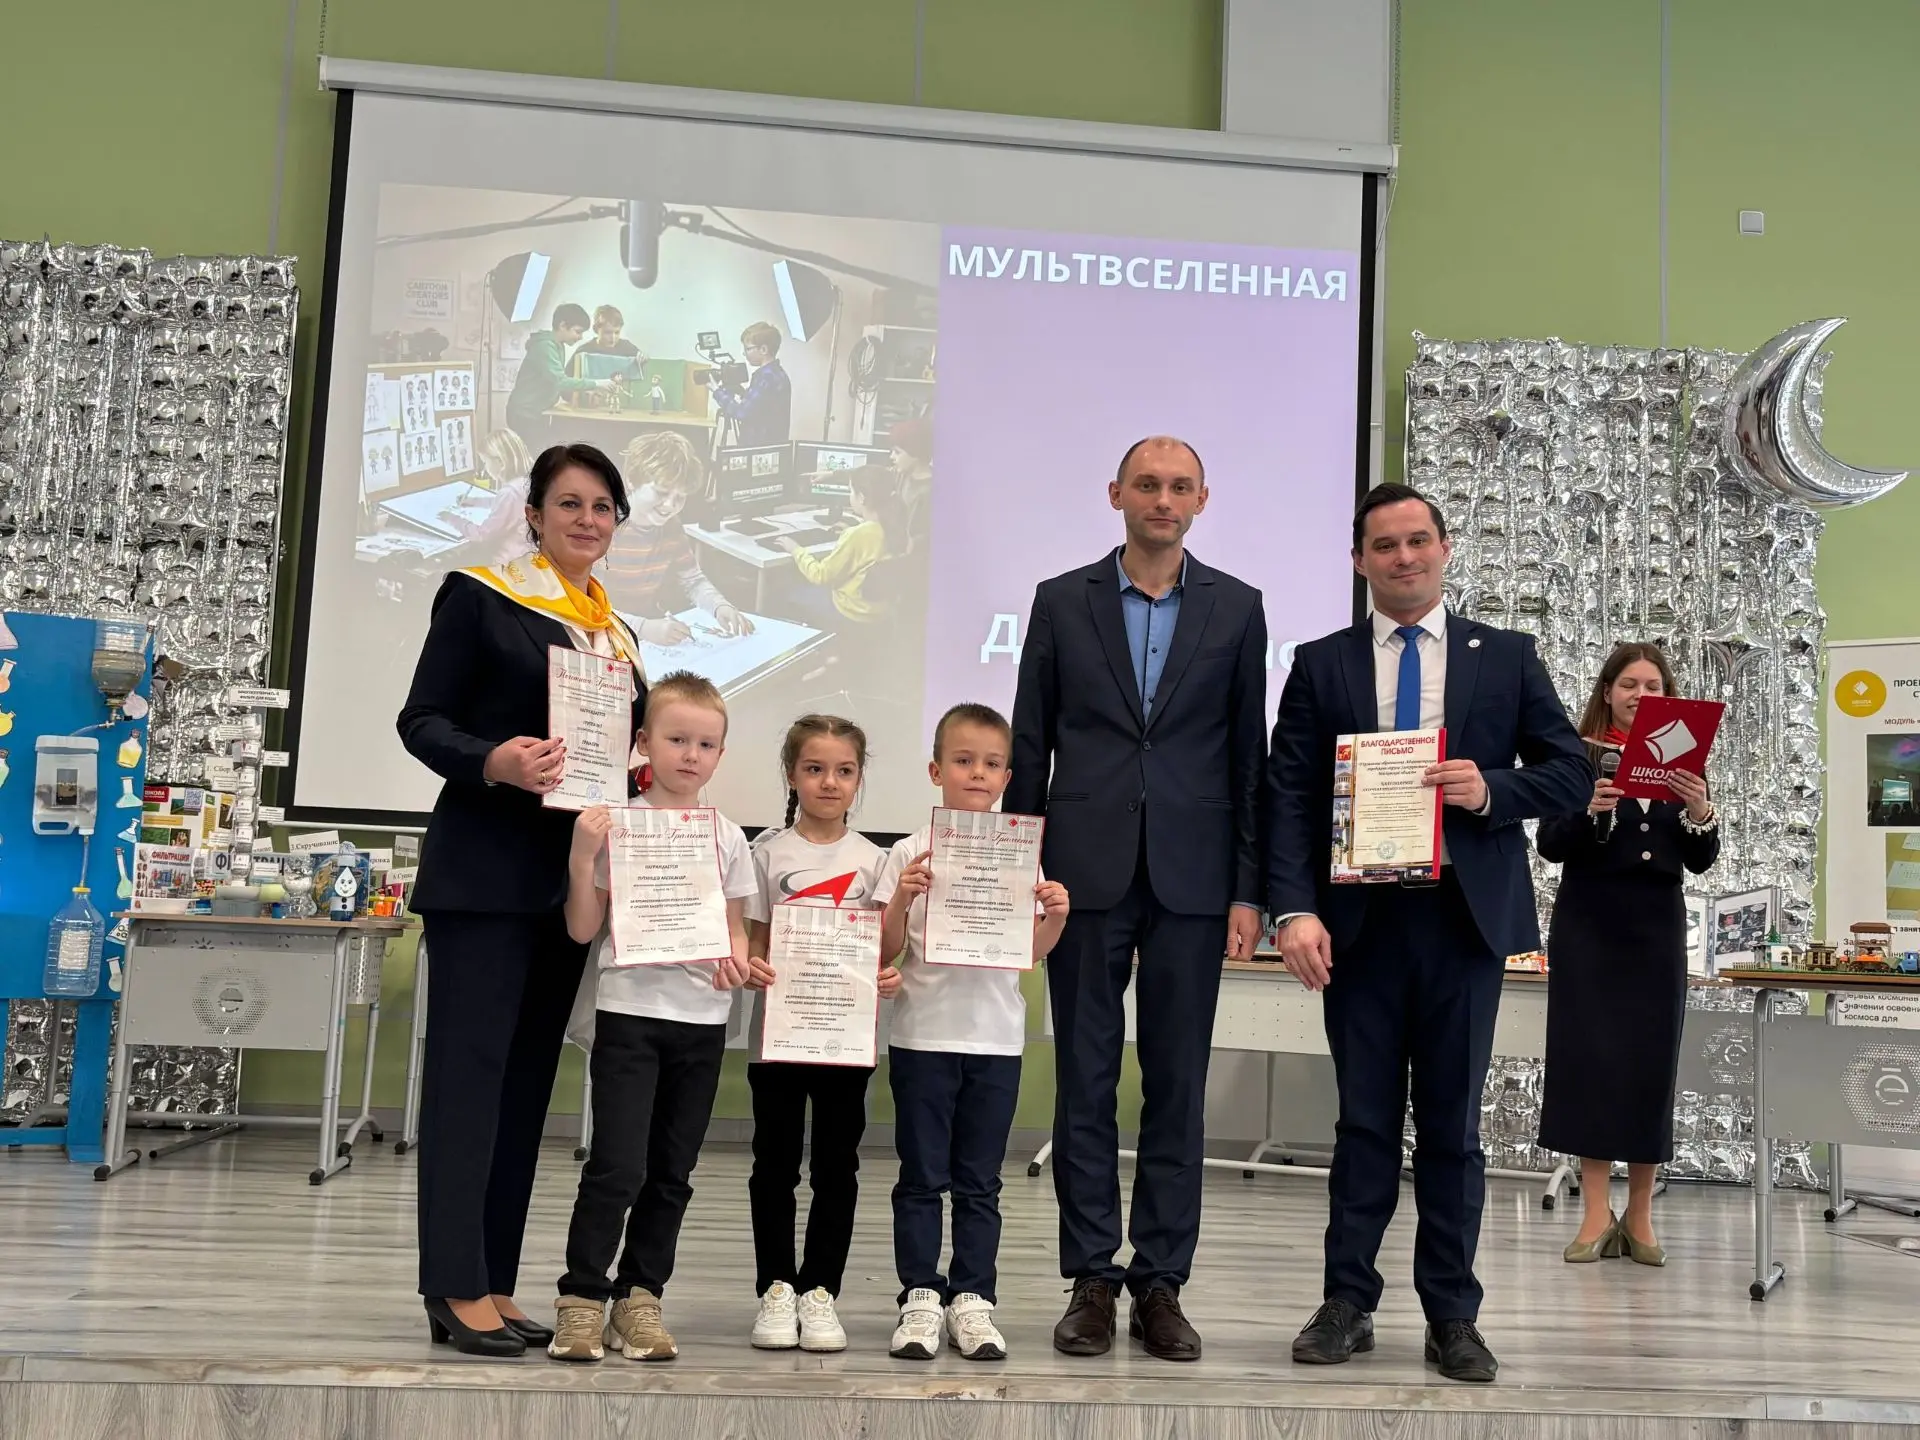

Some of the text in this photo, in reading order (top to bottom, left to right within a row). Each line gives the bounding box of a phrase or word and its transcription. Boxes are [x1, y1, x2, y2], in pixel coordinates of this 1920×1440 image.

[948, 243, 1348, 301] МУЛЬТВСЕЛЕННАЯ
[1360, 737, 1436, 747] БЛАГОДАРСТВЕННОЕ
[1380, 747, 1414, 755] ПИСЬМО
[1631, 766, 1676, 780] ШКОЛ
[1886, 1005, 1920, 1013] освоени
[1844, 1013, 1898, 1023] космоса для
